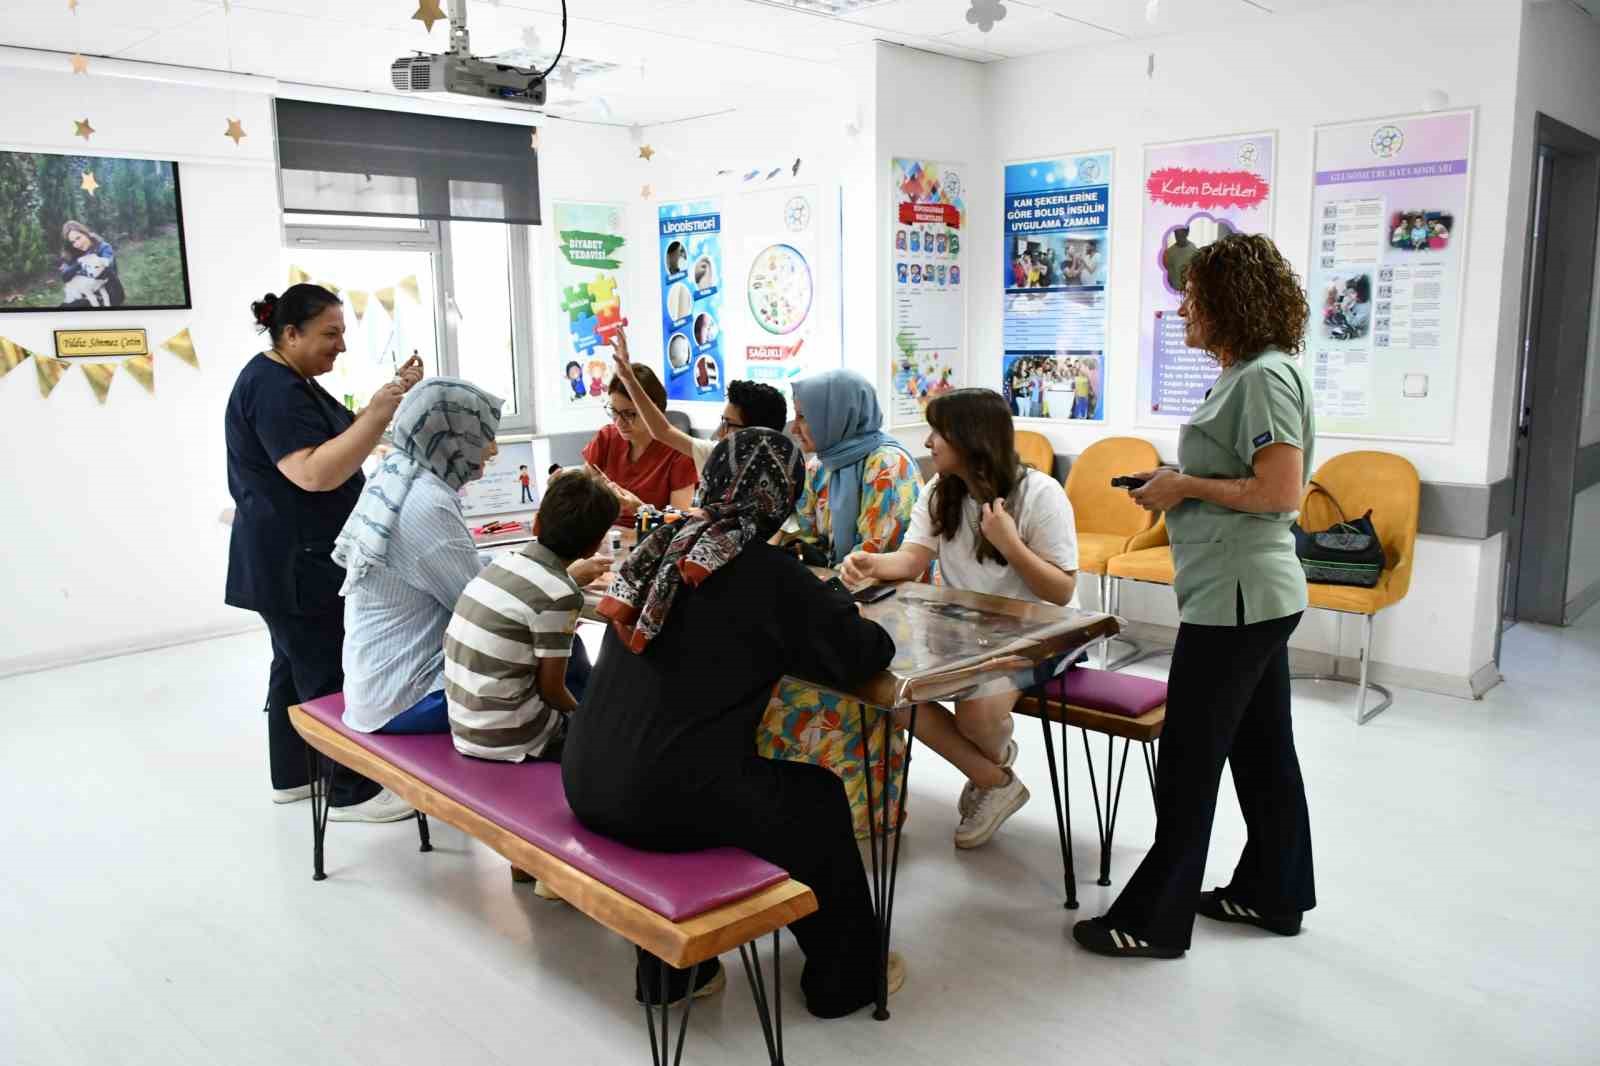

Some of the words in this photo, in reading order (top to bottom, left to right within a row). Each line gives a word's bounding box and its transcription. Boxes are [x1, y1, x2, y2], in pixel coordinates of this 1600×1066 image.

[1201, 182, 1257, 197] Belirtileri
[1014, 199, 1033, 208] KAN
[1034, 192, 1099, 208] ŞEKERLERİNE
[1007, 208, 1033, 220] GÖRE
[1034, 206, 1065, 218] BOLUS
[1067, 201, 1105, 215] İNSÜLİN
[1011, 219, 1061, 231] UYGULAMA
[1063, 216, 1100, 227] ZAMANI
